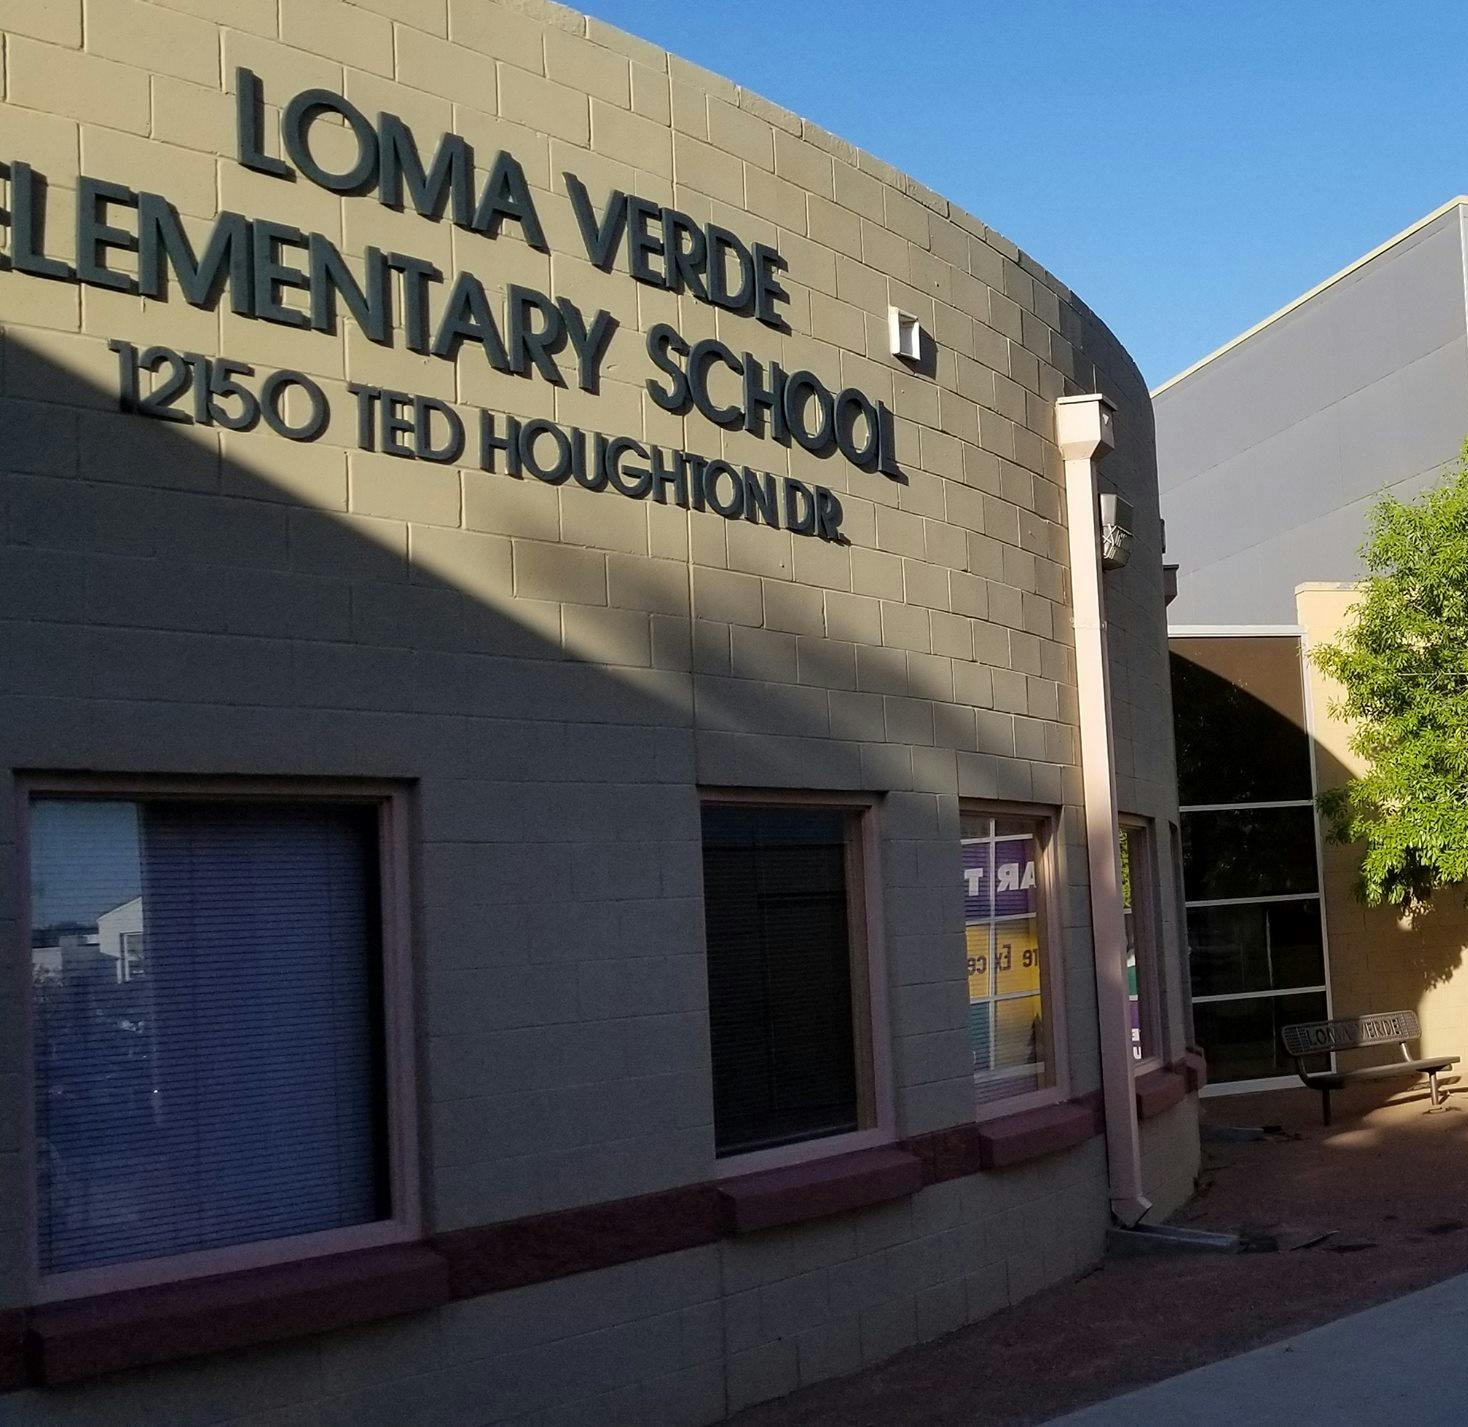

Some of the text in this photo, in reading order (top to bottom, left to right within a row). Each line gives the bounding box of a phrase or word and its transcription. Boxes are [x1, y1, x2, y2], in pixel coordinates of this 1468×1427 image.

[0, 160, 907, 484] LEMENTARY SCHOOL
[236, 67, 786, 329] LOMA VERDE
[108, 339, 330, 443] 12150
[347, 381, 466, 465] TED
[480, 408, 779, 530] HOUGHTON
